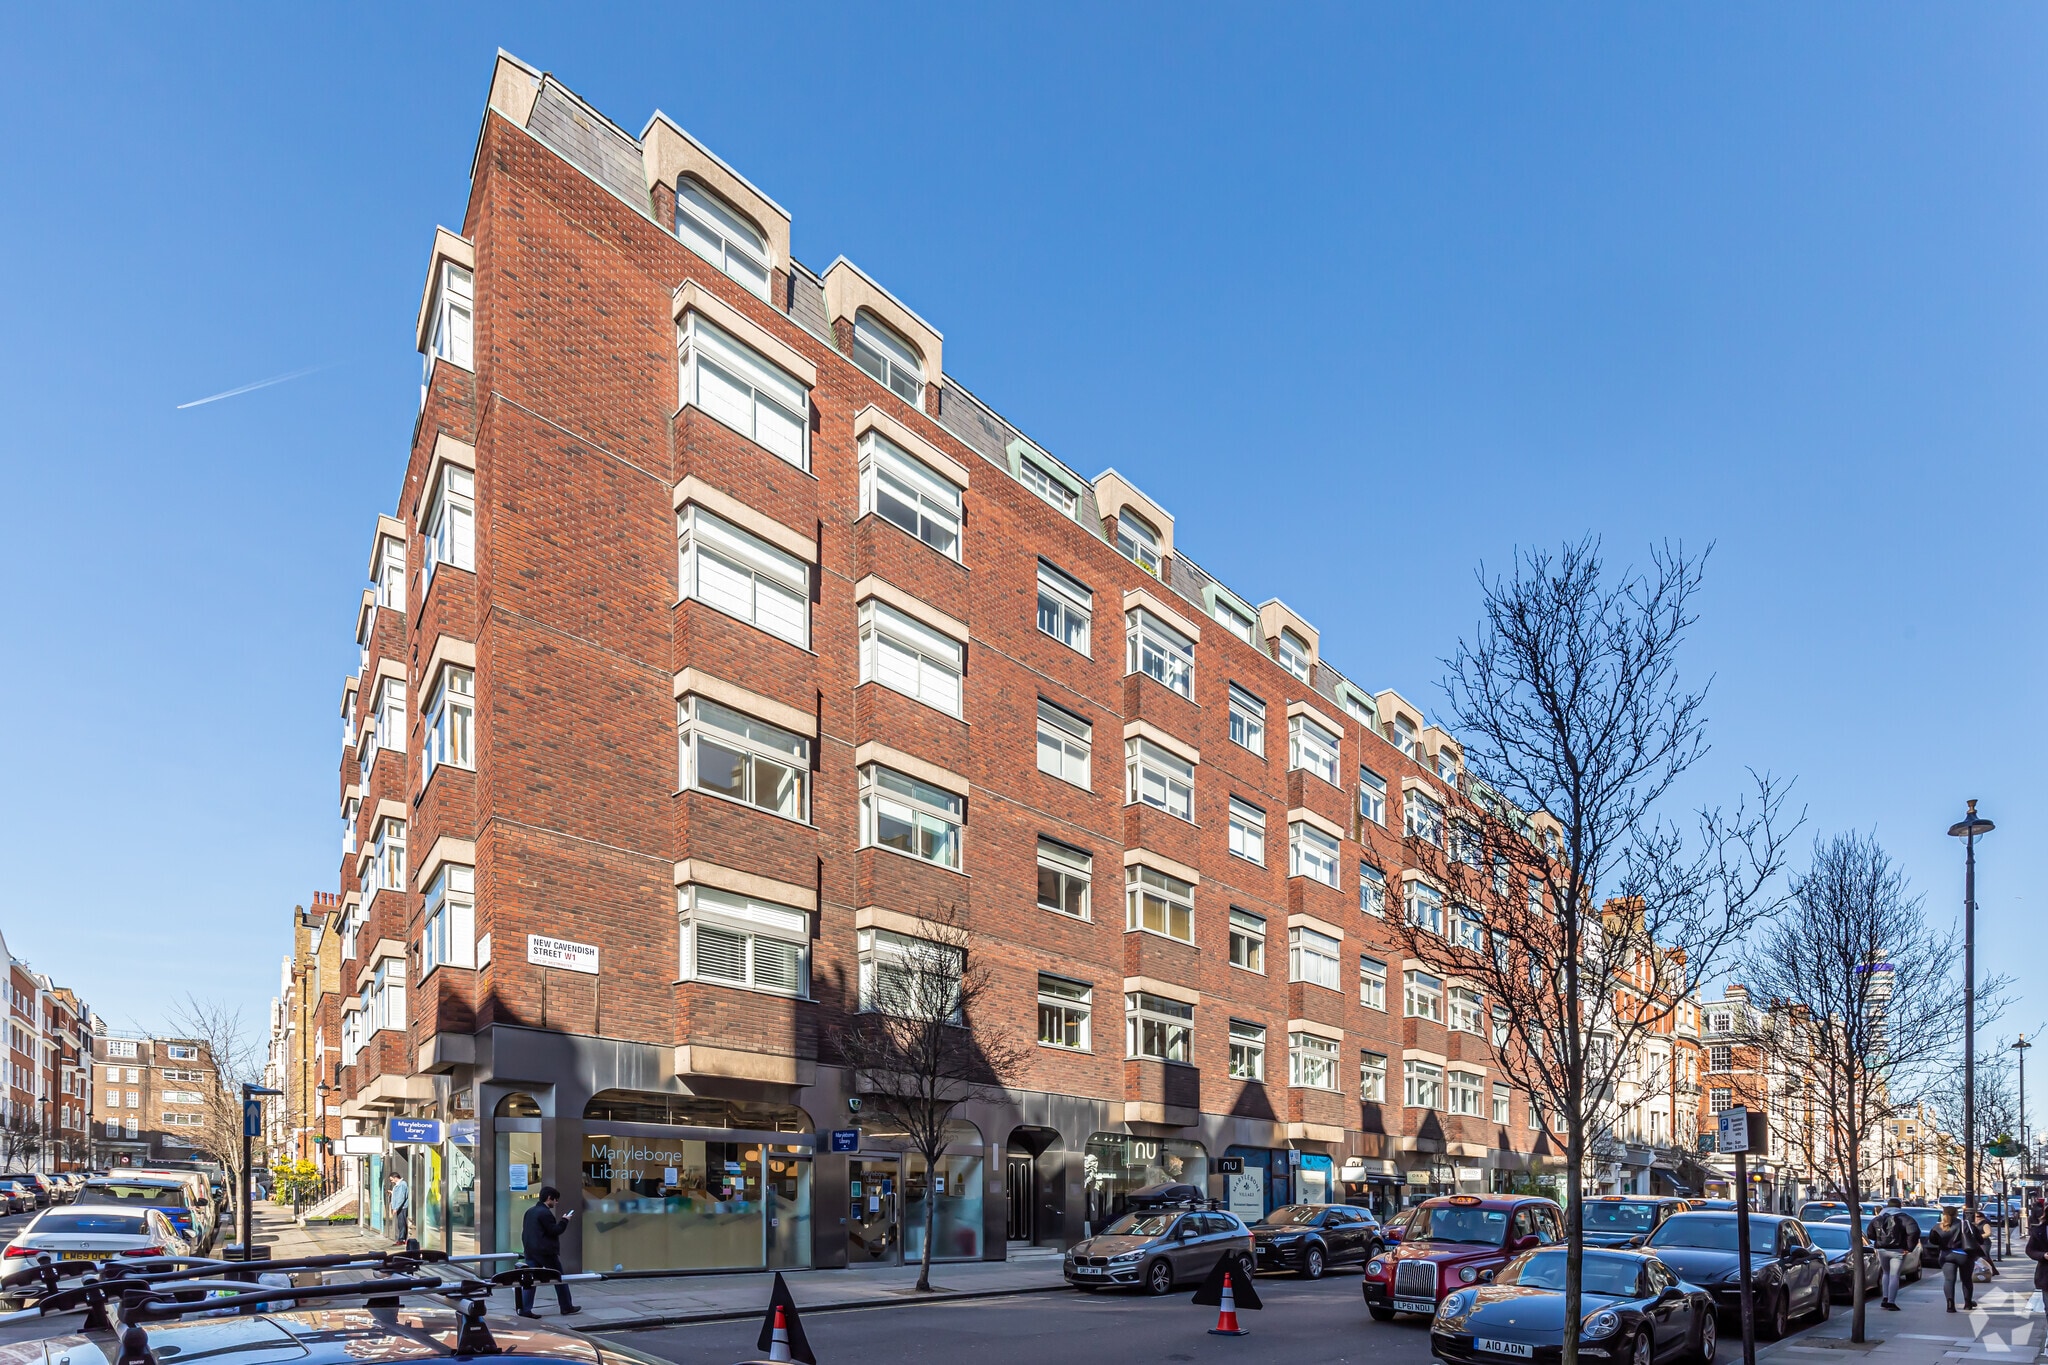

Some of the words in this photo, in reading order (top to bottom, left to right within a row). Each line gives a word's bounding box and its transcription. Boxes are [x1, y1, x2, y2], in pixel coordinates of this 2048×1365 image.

[534, 938, 551, 948] NEW
[554, 942, 595, 956] CAVENDISH
[534, 948, 562, 958] STREET
[565, 952, 576, 961] W1
[398, 1121, 433, 1129] Marylebone
[591, 1143, 682, 1164] Marylebone
[591, 1163, 644, 1184] Library
[63, 1252, 89, 1260] LM69
[1398, 1302, 1414, 1310] LP61
[1485, 1340, 1501, 1351] A10
[1504, 1342, 1525, 1355] ADN
